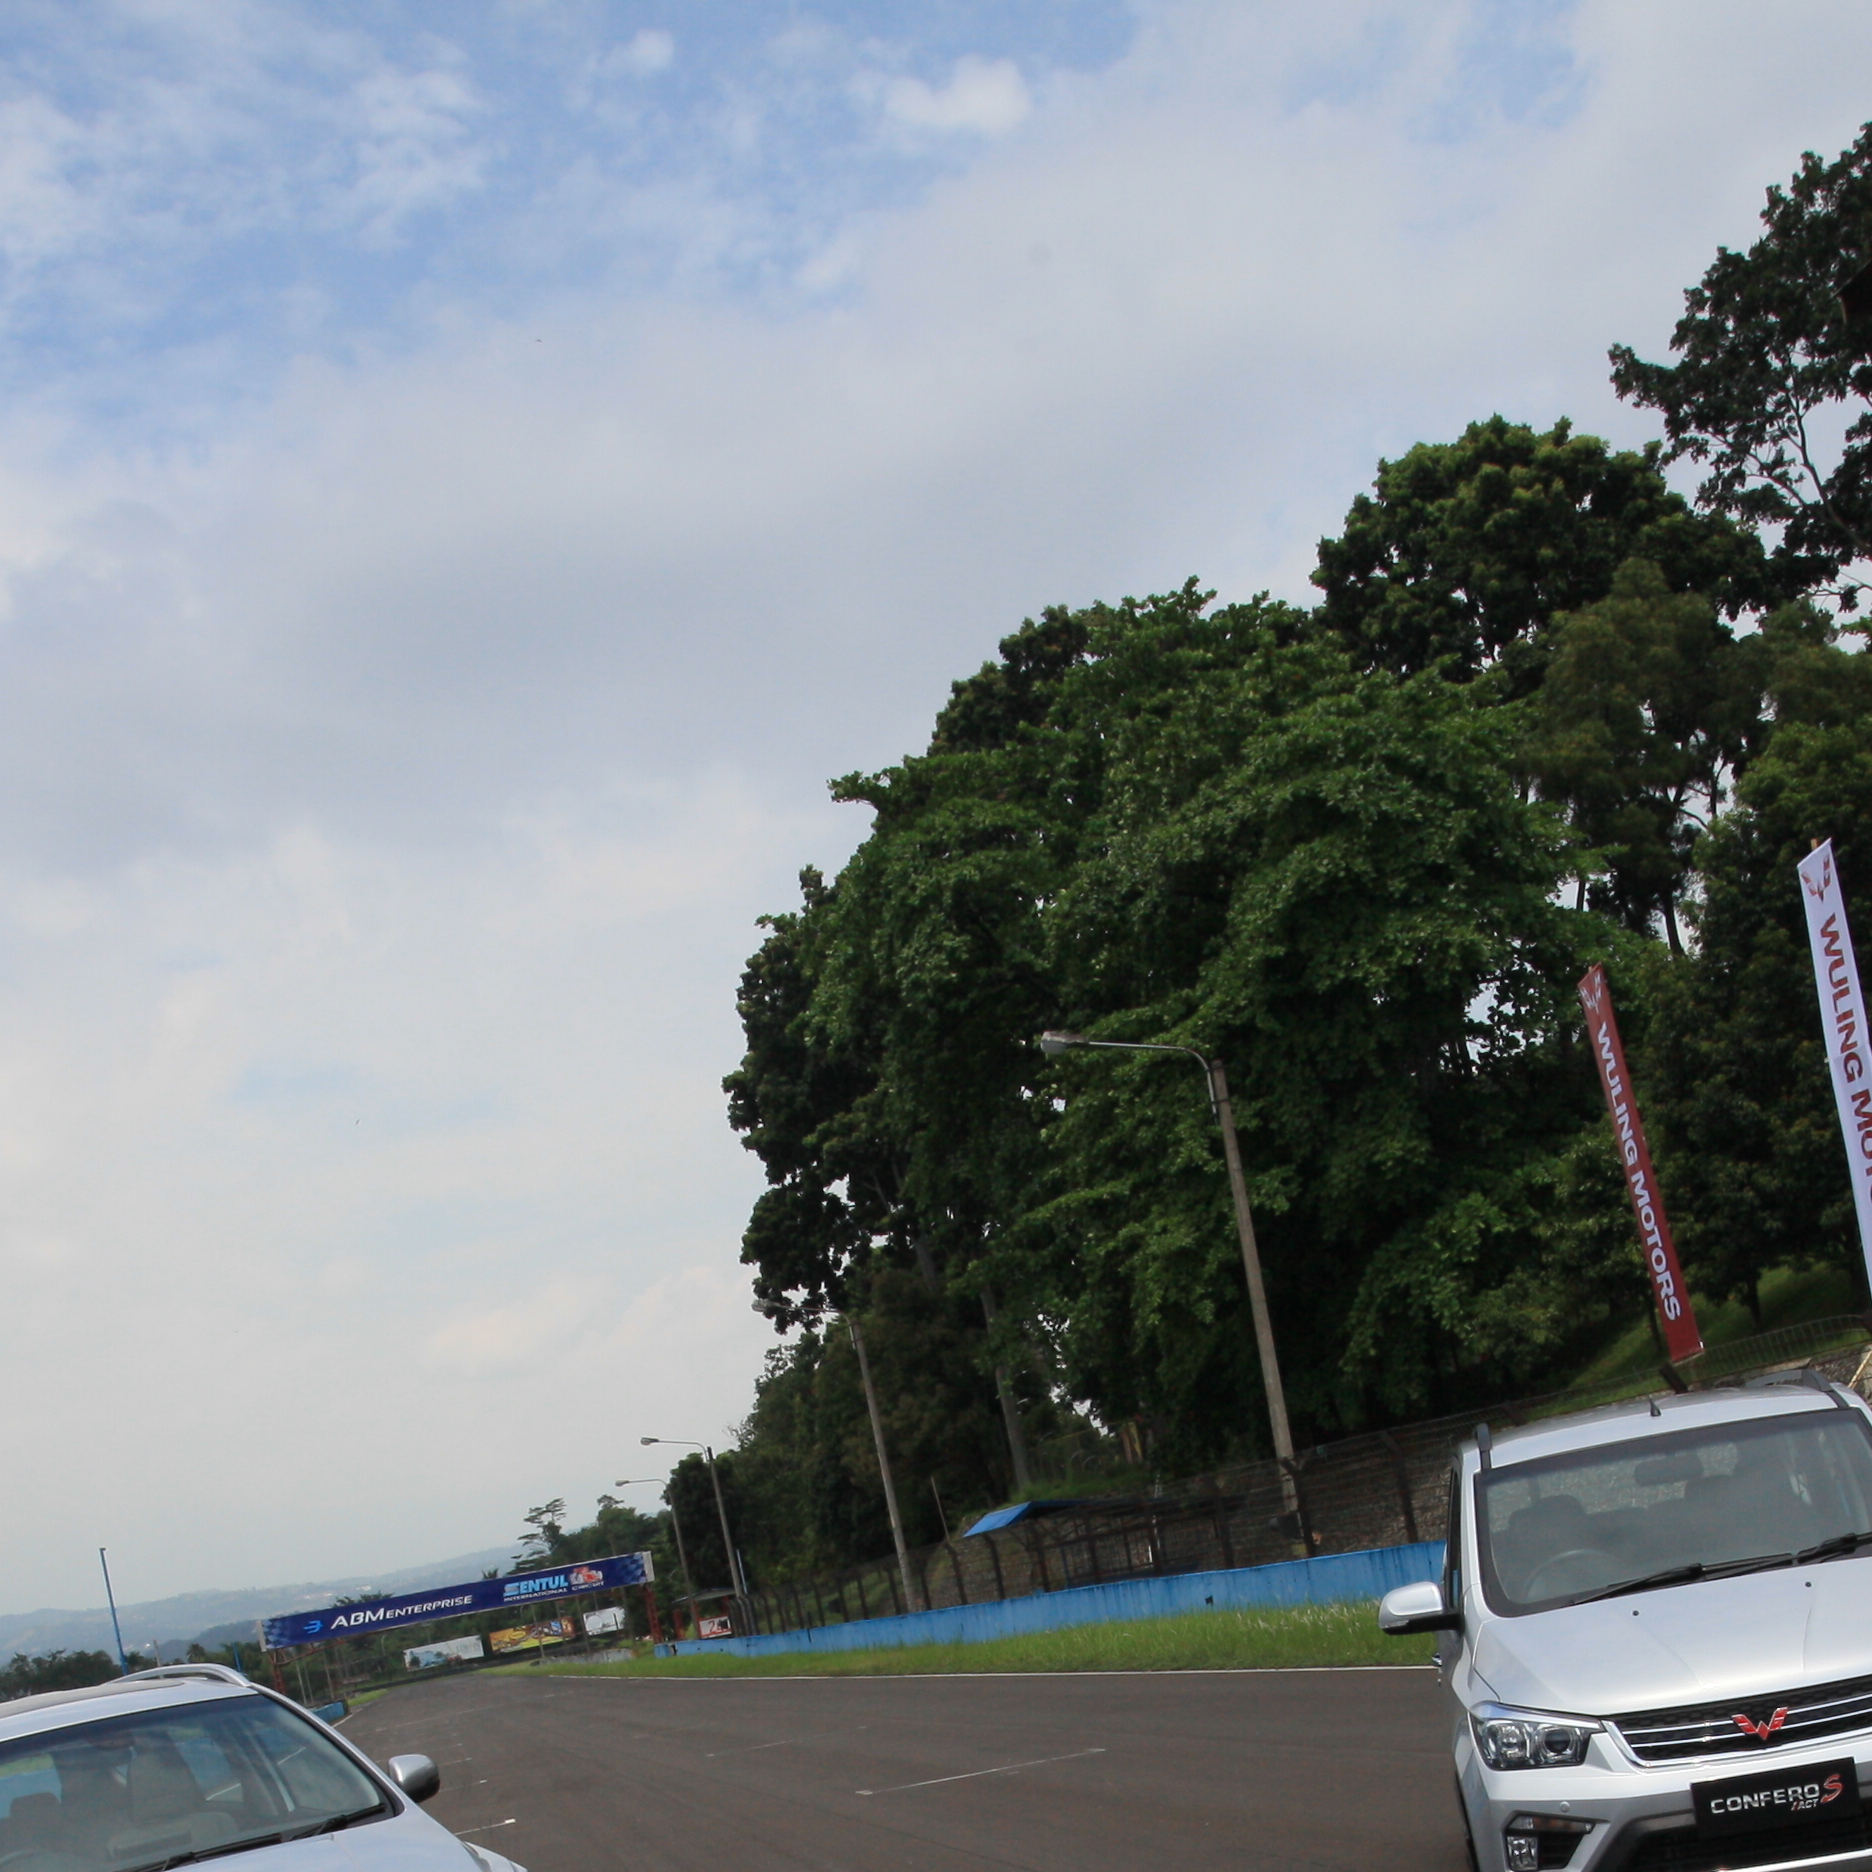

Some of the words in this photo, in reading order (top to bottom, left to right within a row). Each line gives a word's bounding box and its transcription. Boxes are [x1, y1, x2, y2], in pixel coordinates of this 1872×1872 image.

[1819, 912, 1864, 1084] WULING
[1597, 1021, 1639, 1167] WULING
[1631, 1170, 1681, 1321] MOTORS
[503, 1574, 569, 1597] SENTUL
[386, 1594, 473, 1619] ENTERPRISE
[1710, 1783, 1820, 1814] CONFERO
[1820, 1773, 1844, 1804] S
